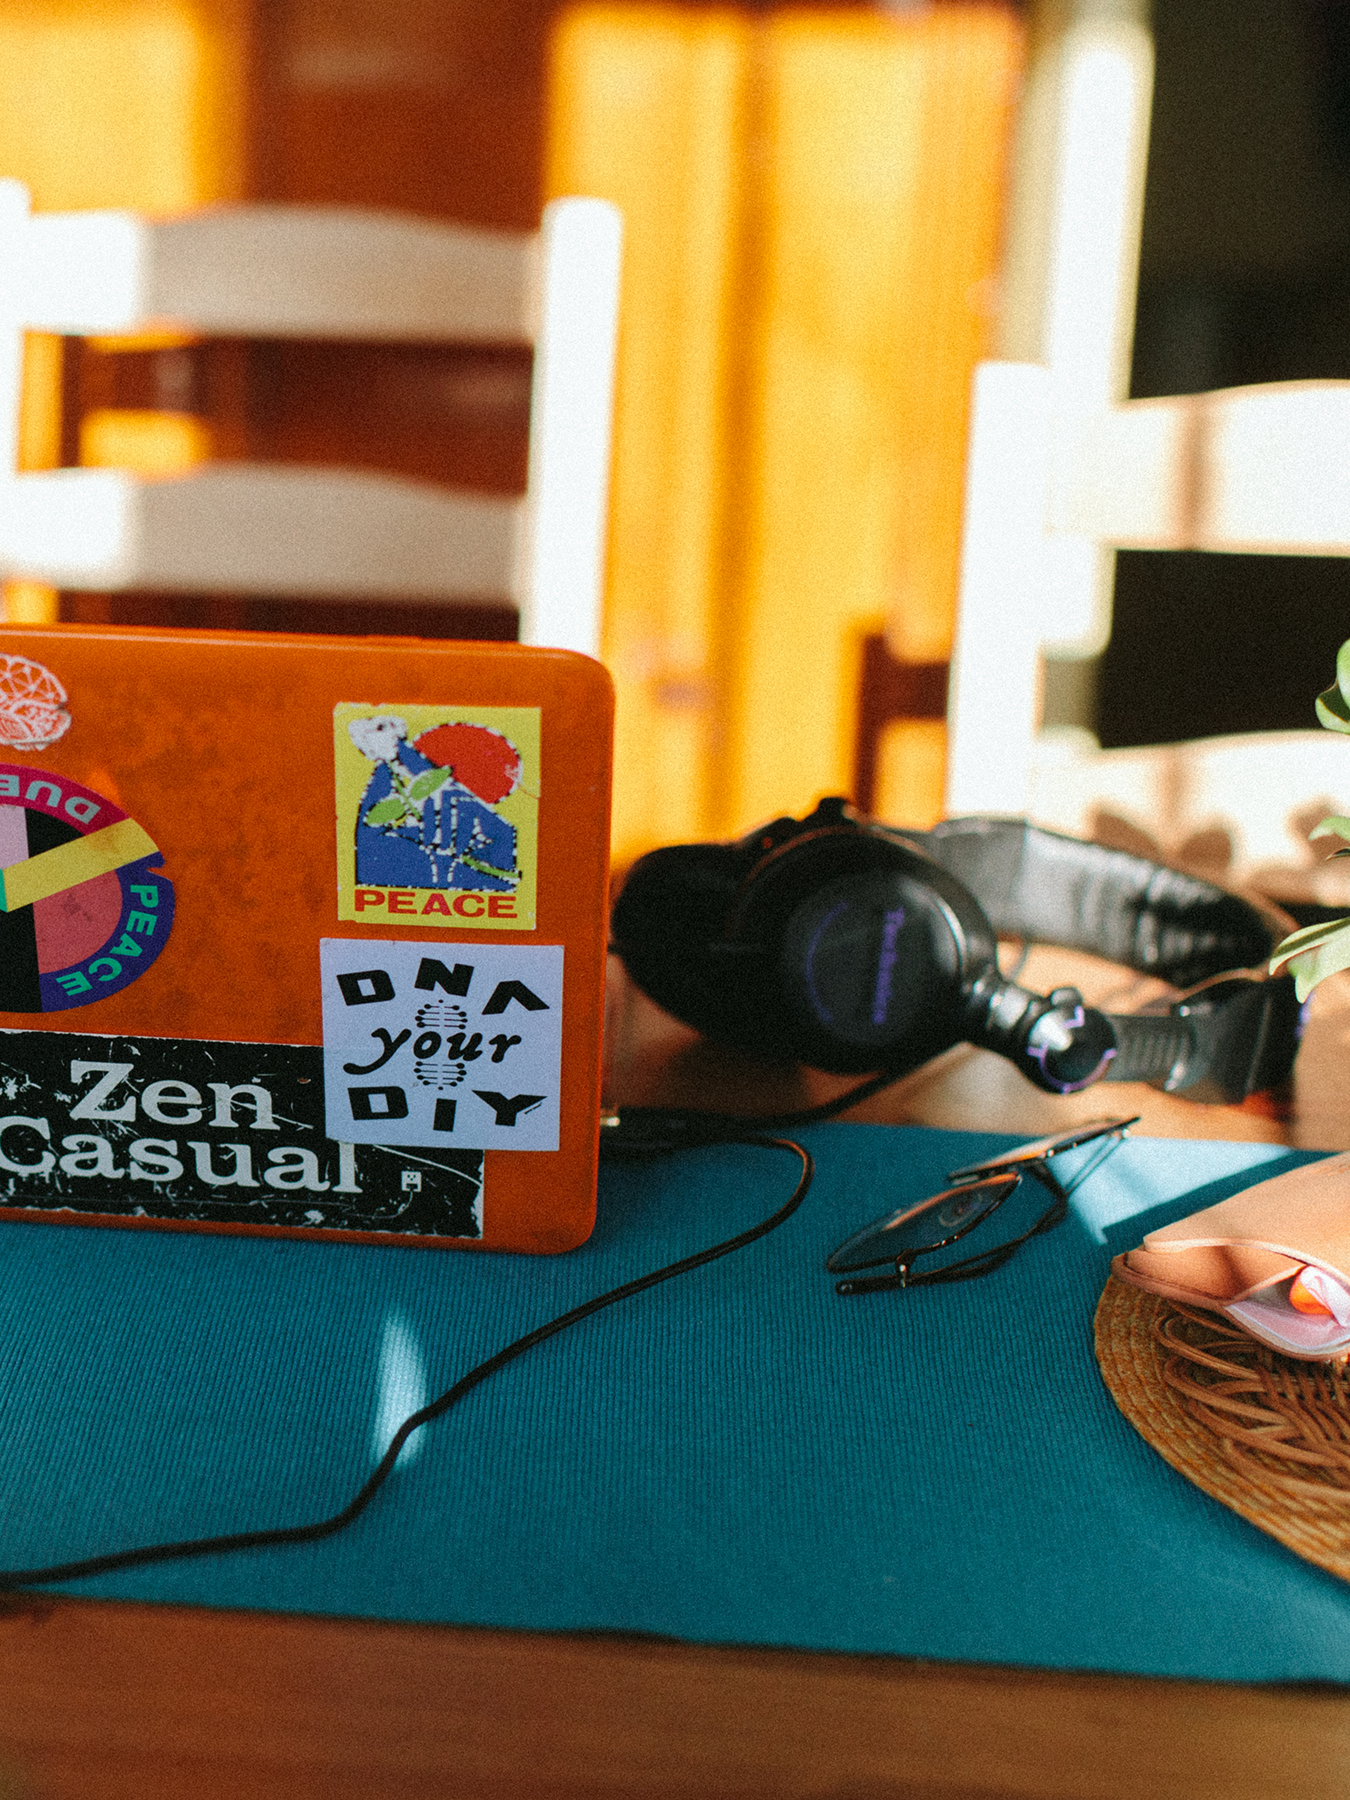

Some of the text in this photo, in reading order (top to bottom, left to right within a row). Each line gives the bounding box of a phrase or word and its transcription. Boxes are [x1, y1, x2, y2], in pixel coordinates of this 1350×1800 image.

[354, 889, 518, 919] PEACE
[55, 884, 159, 997] PEACE
[336, 957, 550, 1015] DNA
[343, 1027, 522, 1075] your
[69, 1060, 280, 1130] Zen
[347, 1086, 548, 1133] DIY
